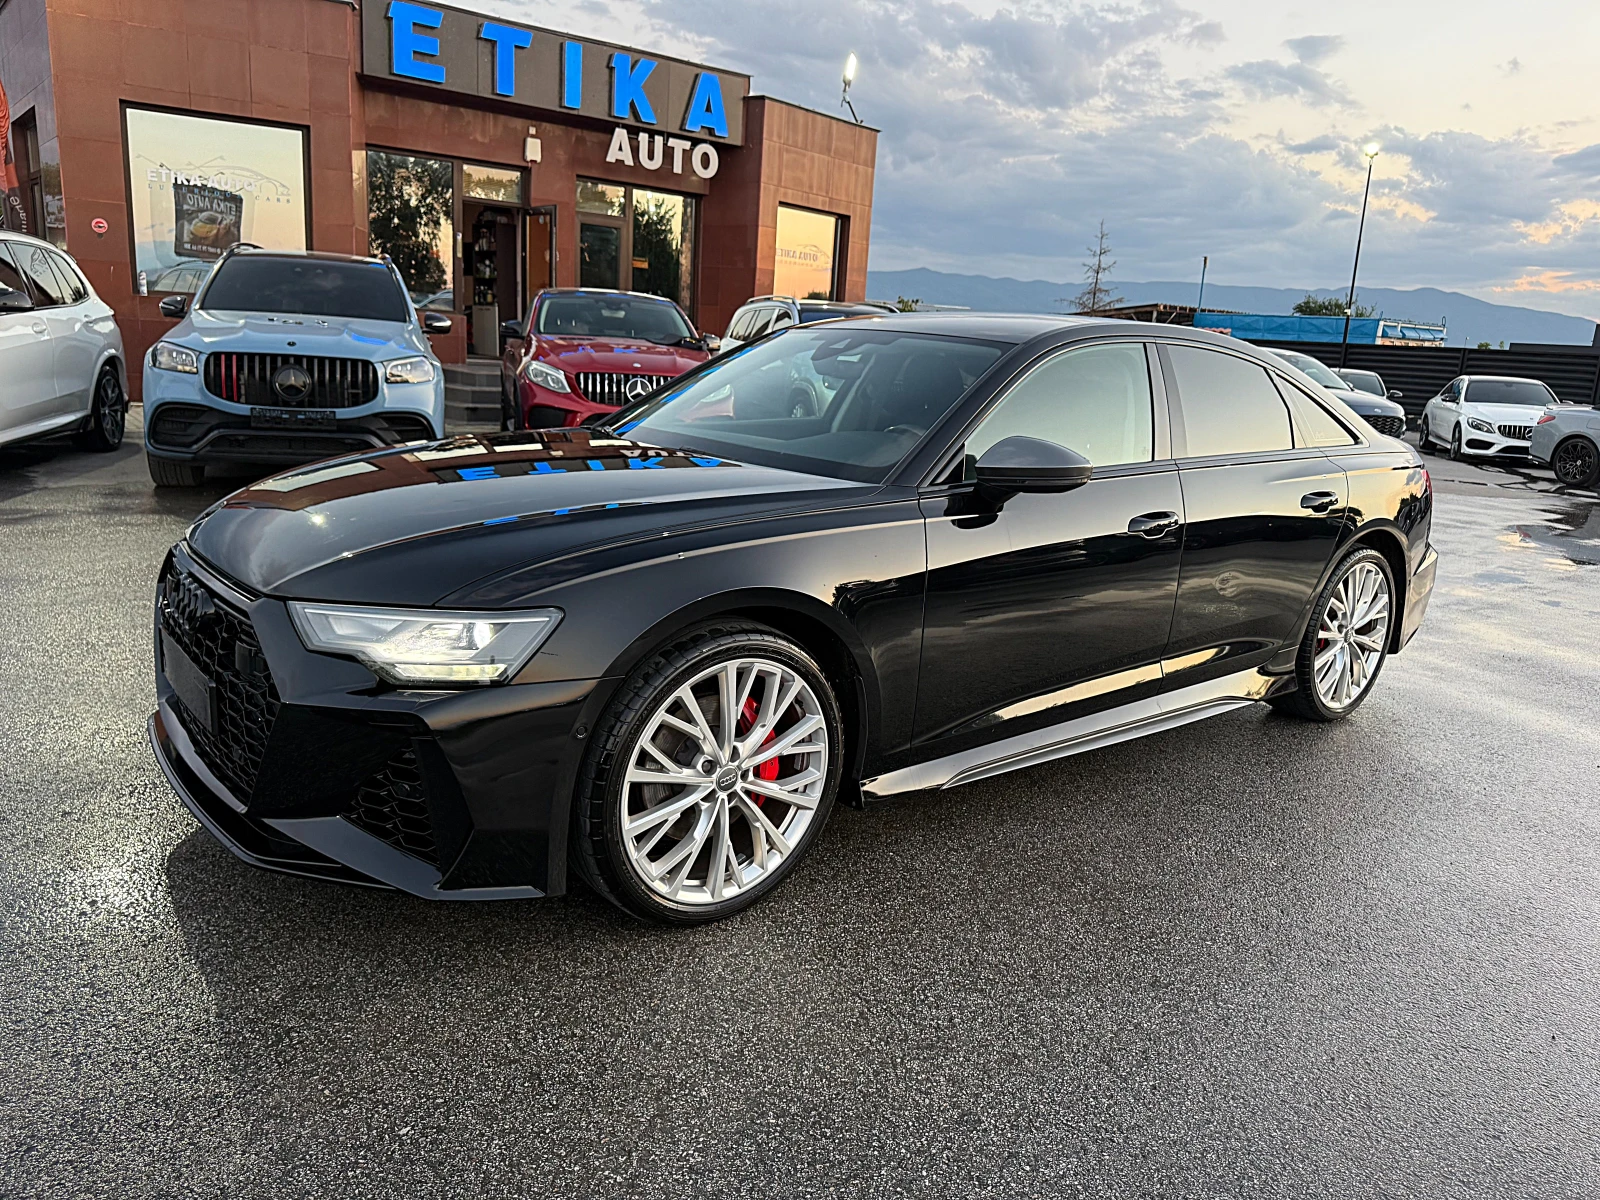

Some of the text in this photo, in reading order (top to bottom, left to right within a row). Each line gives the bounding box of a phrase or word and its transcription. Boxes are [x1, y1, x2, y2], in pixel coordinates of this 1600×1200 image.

[388, 0, 728, 138] ETIKA
[606, 128, 719, 179] AUTO
[146, 168, 256, 192] ETIKA AUTO
